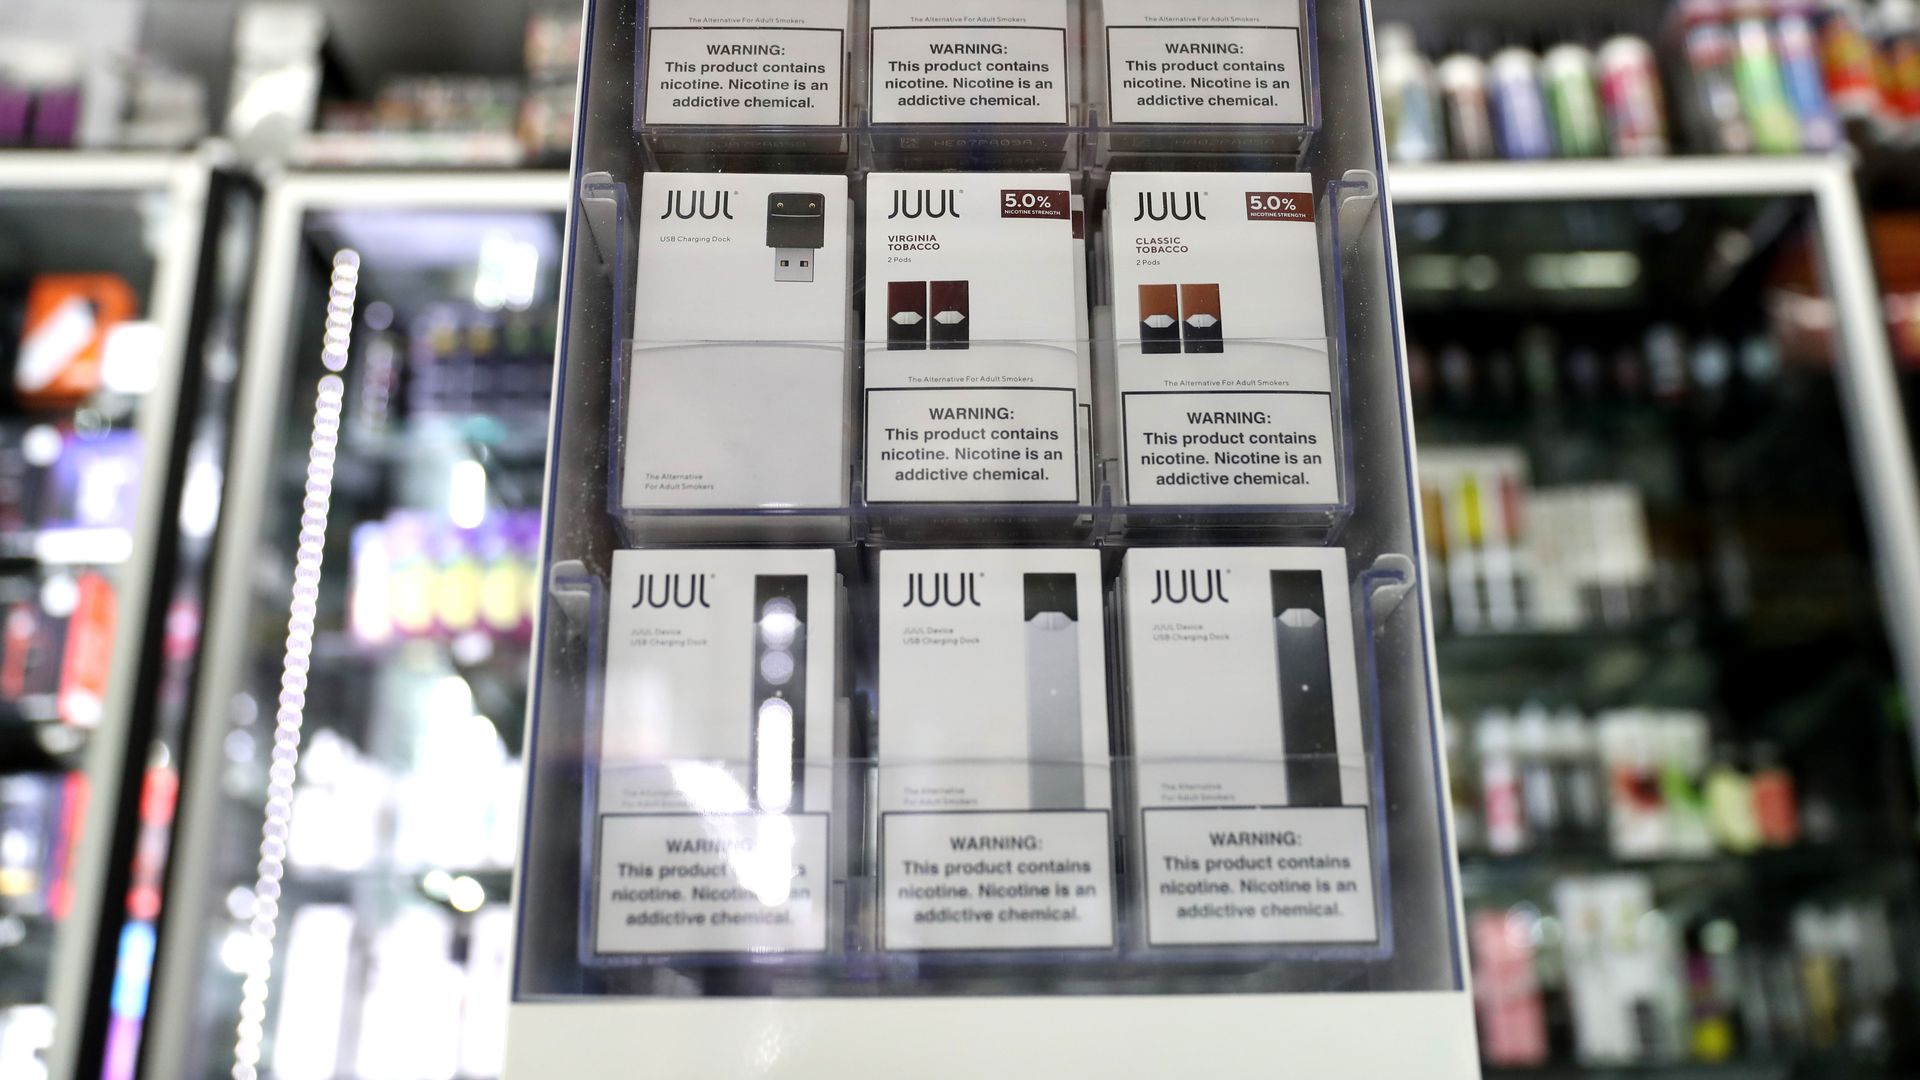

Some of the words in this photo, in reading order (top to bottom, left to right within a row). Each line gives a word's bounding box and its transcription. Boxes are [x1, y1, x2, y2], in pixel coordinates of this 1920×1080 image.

[706, 45, 785, 56] WARNING:
[929, 44, 1008, 54] WARNING:
[1165, 43, 1244, 54] WARNING:
[665, 61, 696, 73] This
[700, 62, 758, 75] product
[762, 63, 826, 74] contains
[888, 61, 920, 72] This
[924, 61, 982, 74] product
[986, 61, 1049, 72] contains
[1125, 60, 1157, 71] This
[1161, 61, 1219, 74] product
[1222, 61, 1285, 72] contains
[660, 79, 723, 90] nicotine.
[728, 79, 790, 90] Nicotine
[793, 80, 806, 90] is
[810, 82, 828, 91] an
[885, 78, 948, 89] nicotine.
[953, 78, 1014, 89] Nicotine
[1018, 78, 1031, 89] is
[1035, 80, 1053, 89] an
[1123, 77, 1186, 89] nicotine.
[1190, 77, 1251, 88] Nicotine
[1255, 78, 1268, 89] is
[1272, 80, 1290, 89] an
[672, 97, 740, 108] addictive
[744, 97, 815, 108] chemical.
[898, 95, 965, 106] addictive
[969, 95, 1040, 106] chemical.
[1137, 95, 1204, 106] addictive
[1208, 95, 1278, 107] chemical.
[1005, 193, 1051, 208] 5.0%
[1250, 195, 1297, 211] 5.0%
[887, 234, 937, 242] VIRGINIA
[1135, 237, 1181, 245] CLASSIC
[887, 242, 941, 251] TOBACCO
[1135, 245, 1189, 254] TOBACCO
[929, 407, 1014, 420] WARNING:
[1186, 412, 1272, 424] WARNING:
[885, 428, 919, 440] This
[923, 427, 986, 443] product
[990, 427, 1059, 440] contains
[1143, 432, 1178, 445] This
[1182, 432, 1245, 447] product
[1249, 431, 1317, 444] contains
[881, 448, 949, 460] nicotine.
[954, 447, 1021, 460] Nicotine
[1025, 447, 1039, 460] is
[1043, 449, 1063, 460] an
[1141, 452, 1210, 465] nicotine.
[1214, 452, 1280, 464] Nicotine
[1284, 452, 1298, 464] is
[1302, 454, 1322, 465] an
[895, 468, 968, 481] addictive
[972, 468, 1049, 480] chemical.
[1156, 472, 1229, 485] addictive
[1233, 472, 1310, 485] chemical.
[950, 836, 1043, 851] WARNING:
[1209, 831, 1302, 846] WARNING:
[617, 863, 654, 878] This
[659, 862, 727, 880] product
[902, 860, 939, 876] This
[944, 860, 1012, 877] product
[1017, 859, 1092, 874] contains
[1163, 856, 1200, 871] This
[1205, 856, 1272, 874] product
[1277, 855, 1351, 870] contains
[898, 884, 973, 900] nicotine.
[978, 883, 1050, 898] Nicotine
[1055, 882, 1070, 897] is
[1075, 884, 1096, 897] an
[1160, 880, 1234, 895] nicotine.
[1240, 879, 1312, 894] Nicotine
[1316, 878, 1331, 893] is
[1336, 881, 1357, 893] an
[611, 887, 685, 902] nicotine.
[913, 907, 993, 923] addictive
[998, 906, 1080, 922] chemical.
[1177, 903, 1256, 919] addictive
[1260, 903, 1343, 918] chemical.
[625, 912, 706, 927] addictive
